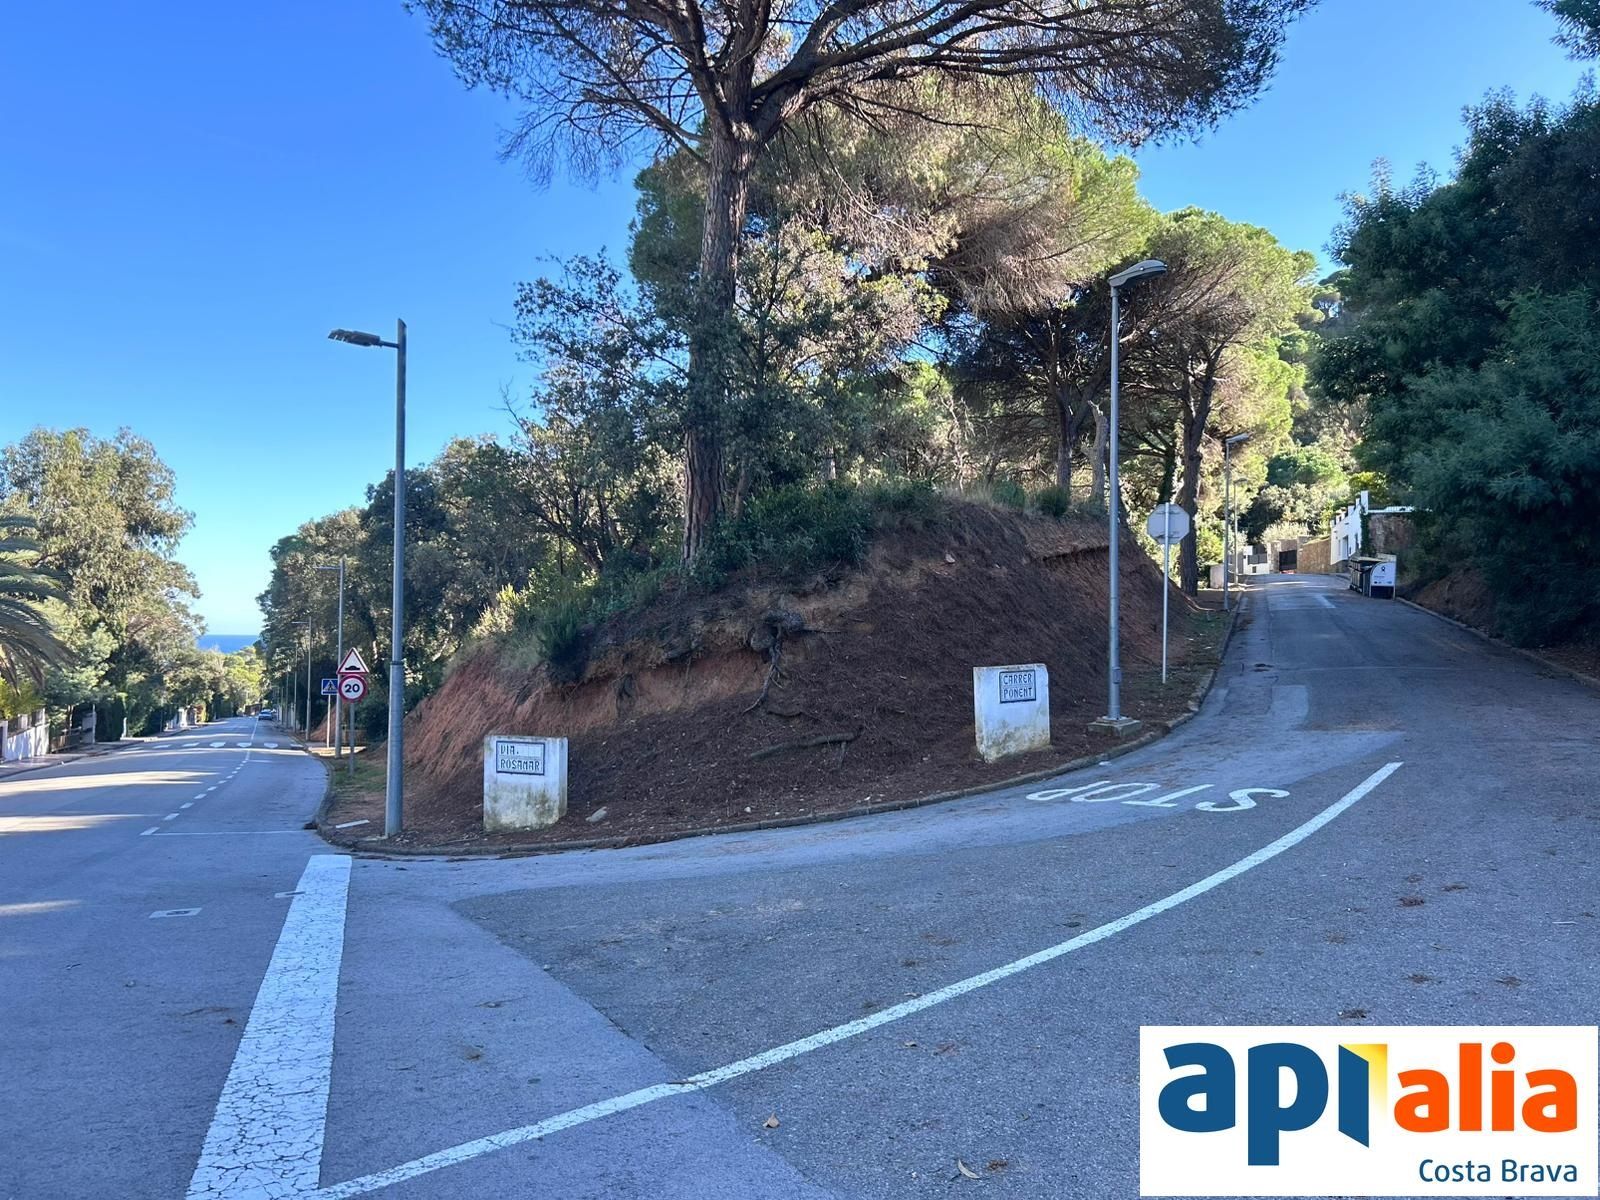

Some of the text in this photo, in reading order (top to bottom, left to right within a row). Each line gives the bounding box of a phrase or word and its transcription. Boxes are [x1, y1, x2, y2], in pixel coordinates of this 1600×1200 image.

[1003, 673, 1032, 685] CARRER
[344, 683, 360, 693] 20
[1003, 687, 1033, 698] PONENT
[500, 759, 540, 771] ROSAMAR
[1025, 780, 1290, 812] STOP
